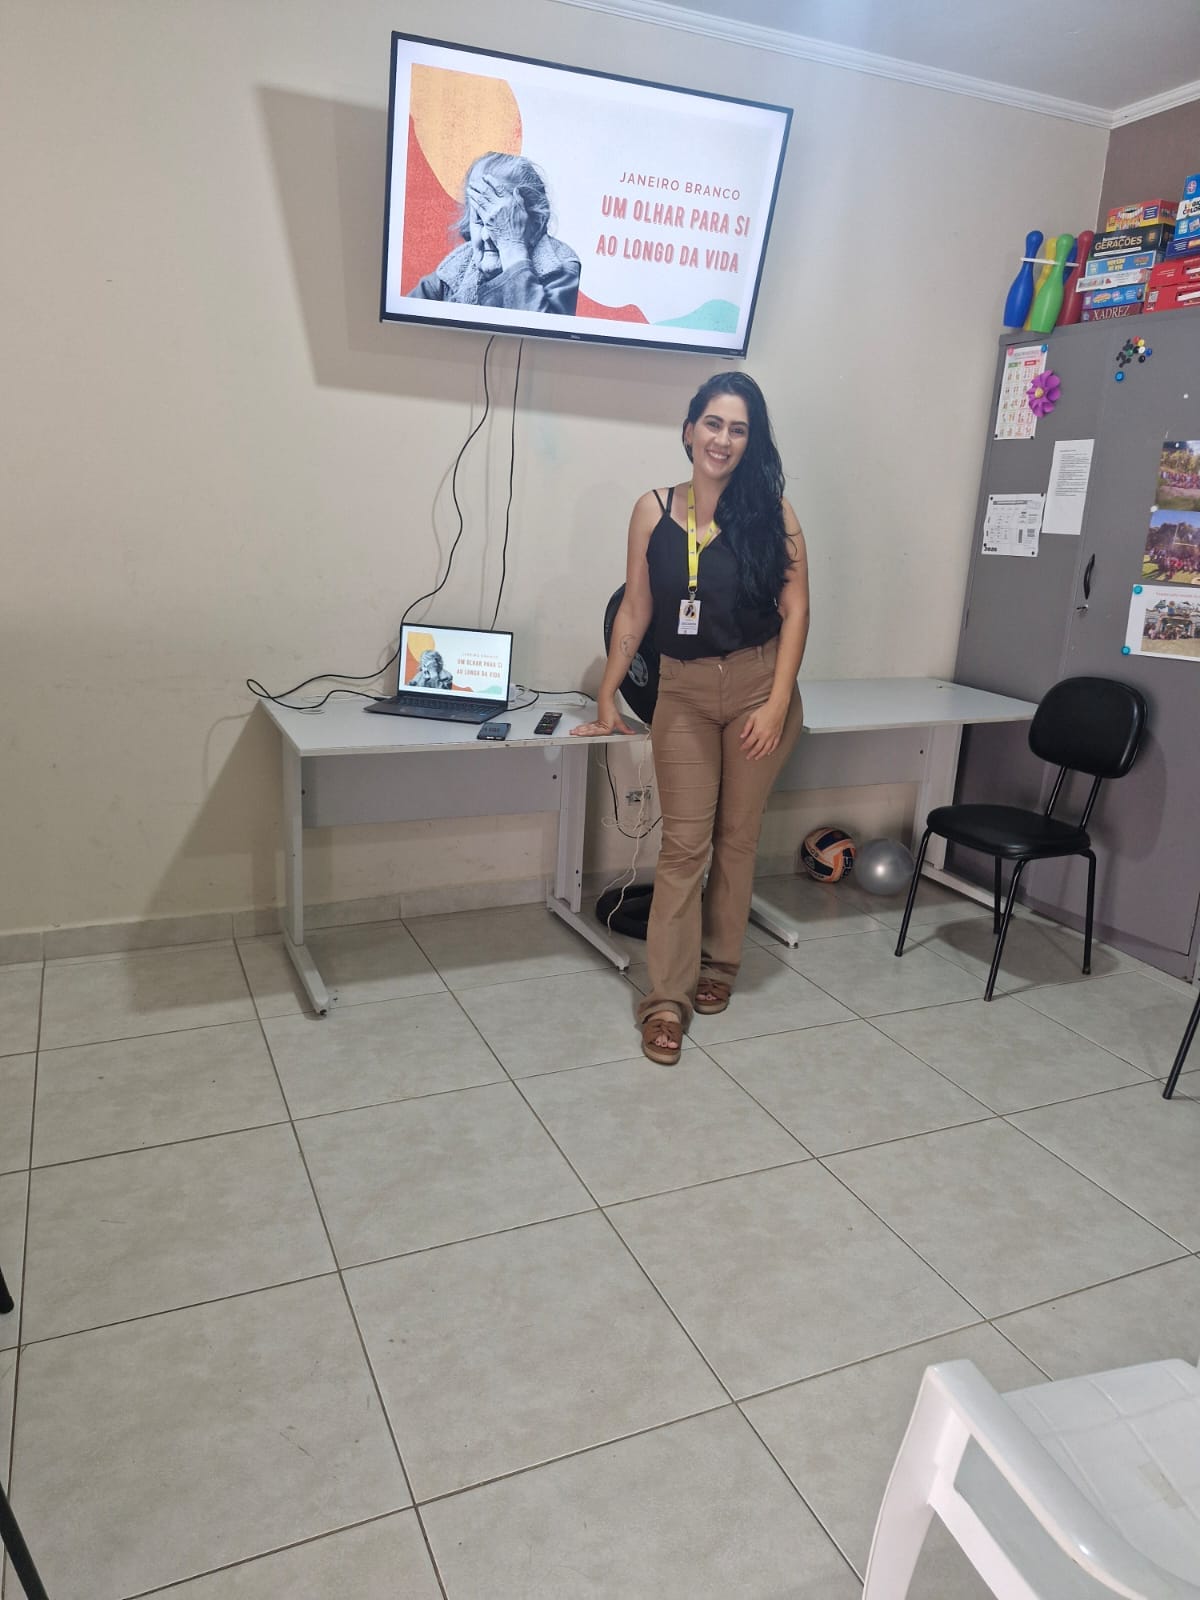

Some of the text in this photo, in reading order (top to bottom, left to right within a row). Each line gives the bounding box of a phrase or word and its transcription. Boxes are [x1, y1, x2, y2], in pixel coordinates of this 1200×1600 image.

[619, 172, 741, 201] JANEIRO BRANCO
[601, 195, 751, 237] UM OLHAR PARA SI
[595, 234, 739, 274] AO LONGO DA VIDA
[1094, 236, 1143, 251] GERAÇÕES
[1093, 306, 1130, 321] XADREZ
